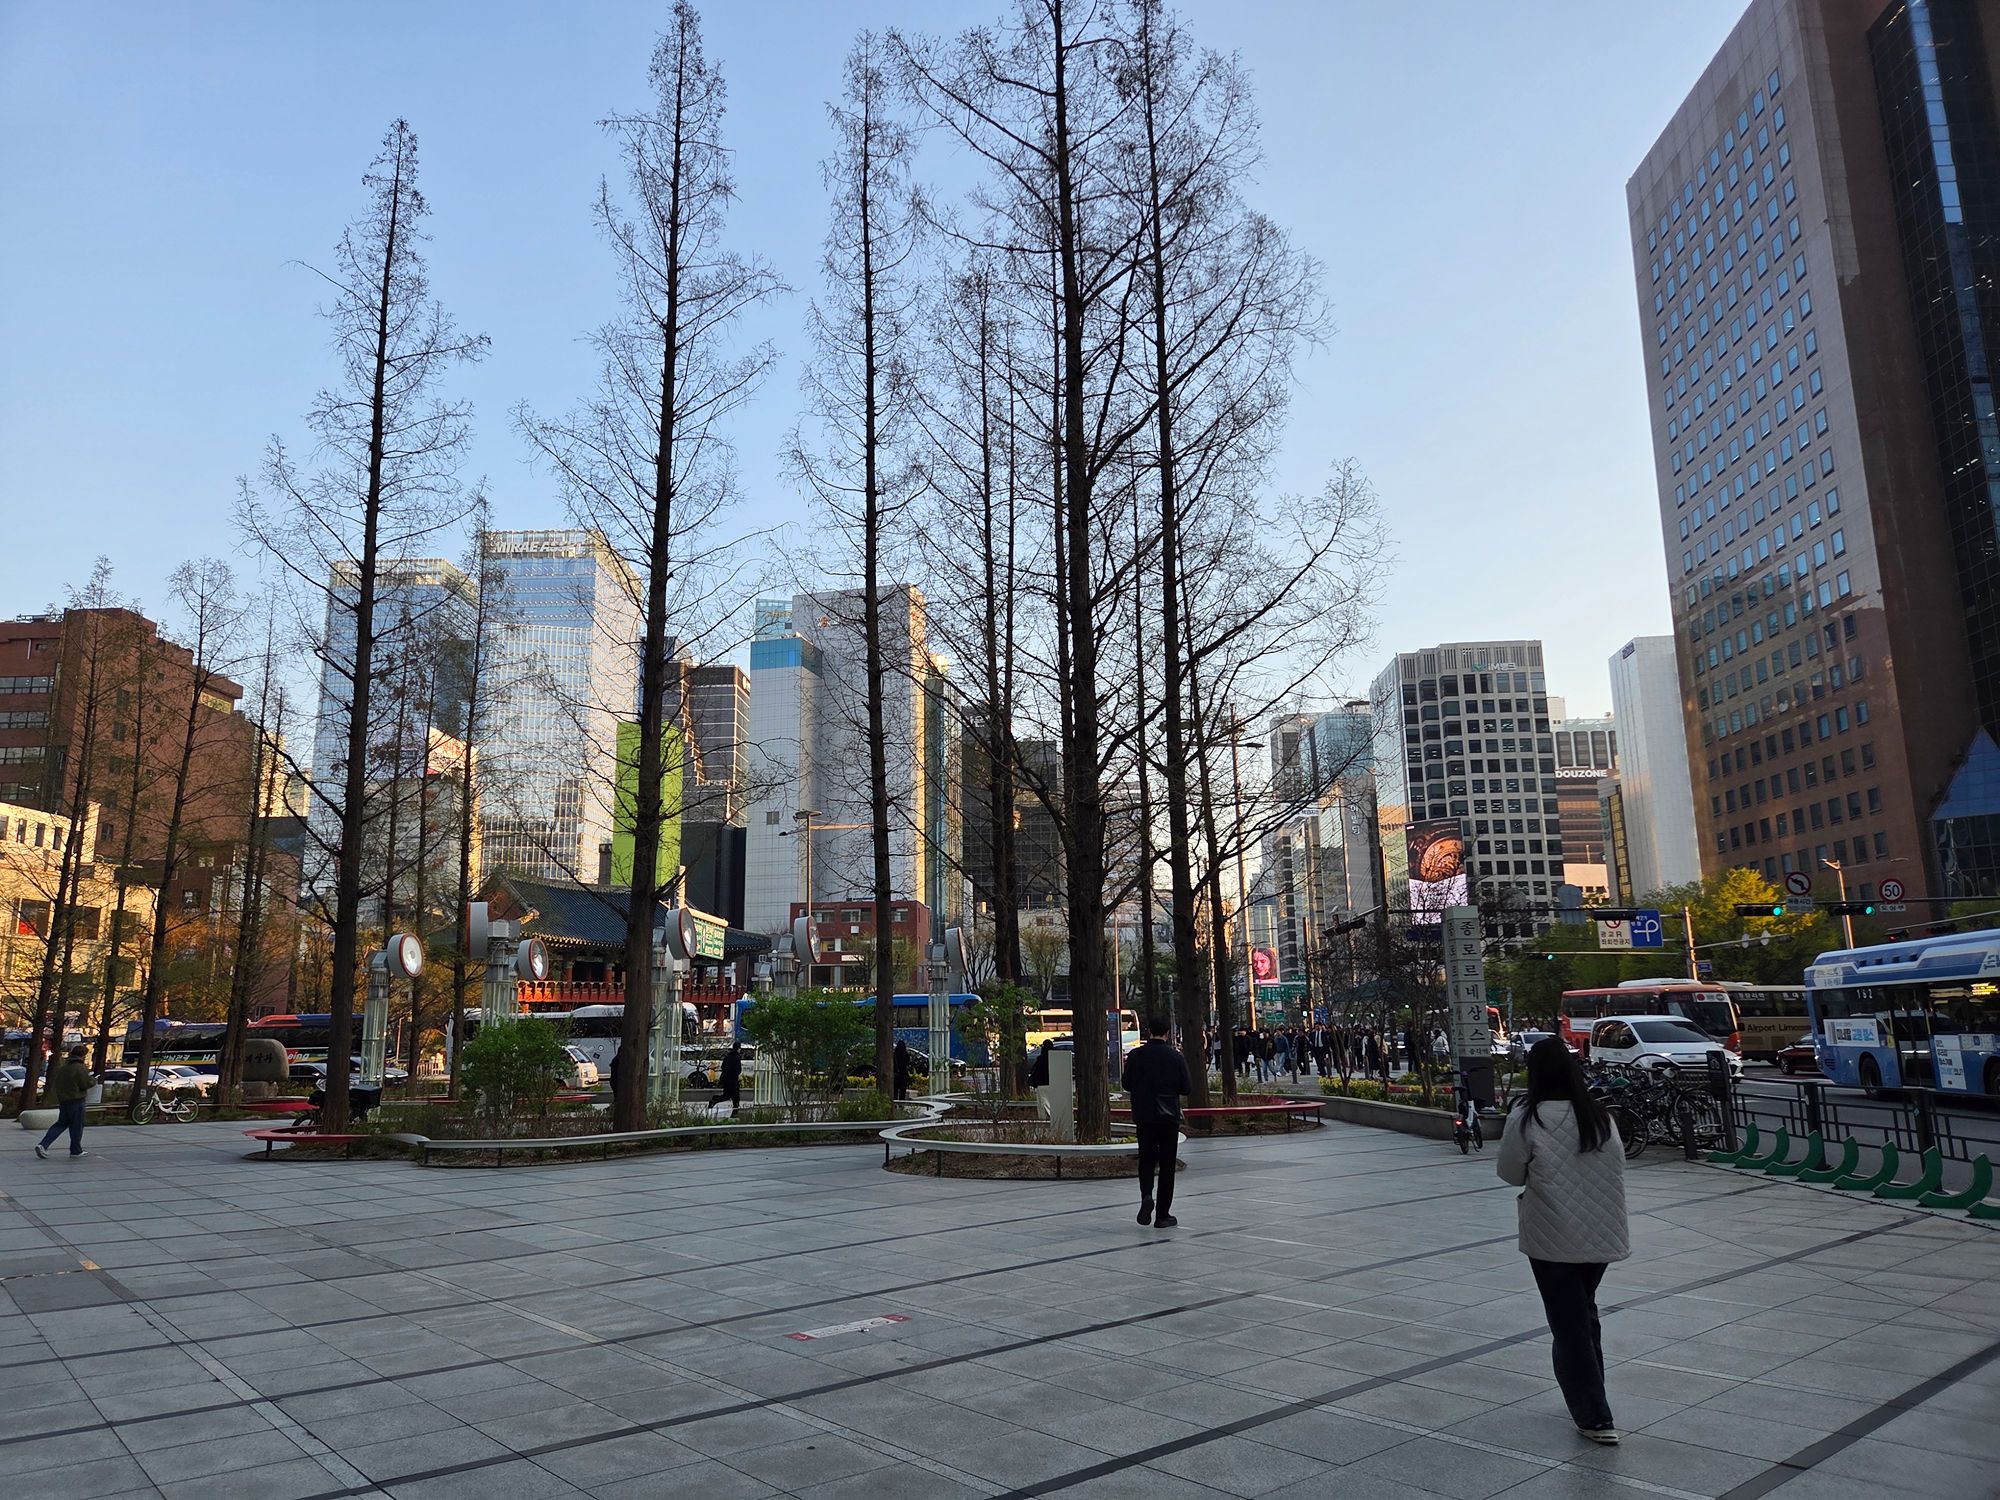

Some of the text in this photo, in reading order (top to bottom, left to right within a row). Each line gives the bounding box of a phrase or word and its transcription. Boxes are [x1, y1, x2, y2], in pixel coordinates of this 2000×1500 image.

[494, 541, 538, 552] MIRAE
[1555, 769, 1608, 778] DOUZONE
[1884, 885, 1900, 897] 50
[1459, 921, 1485, 1041] 종로르네상스
[1747, 1024, 1776, 1032] Airport
